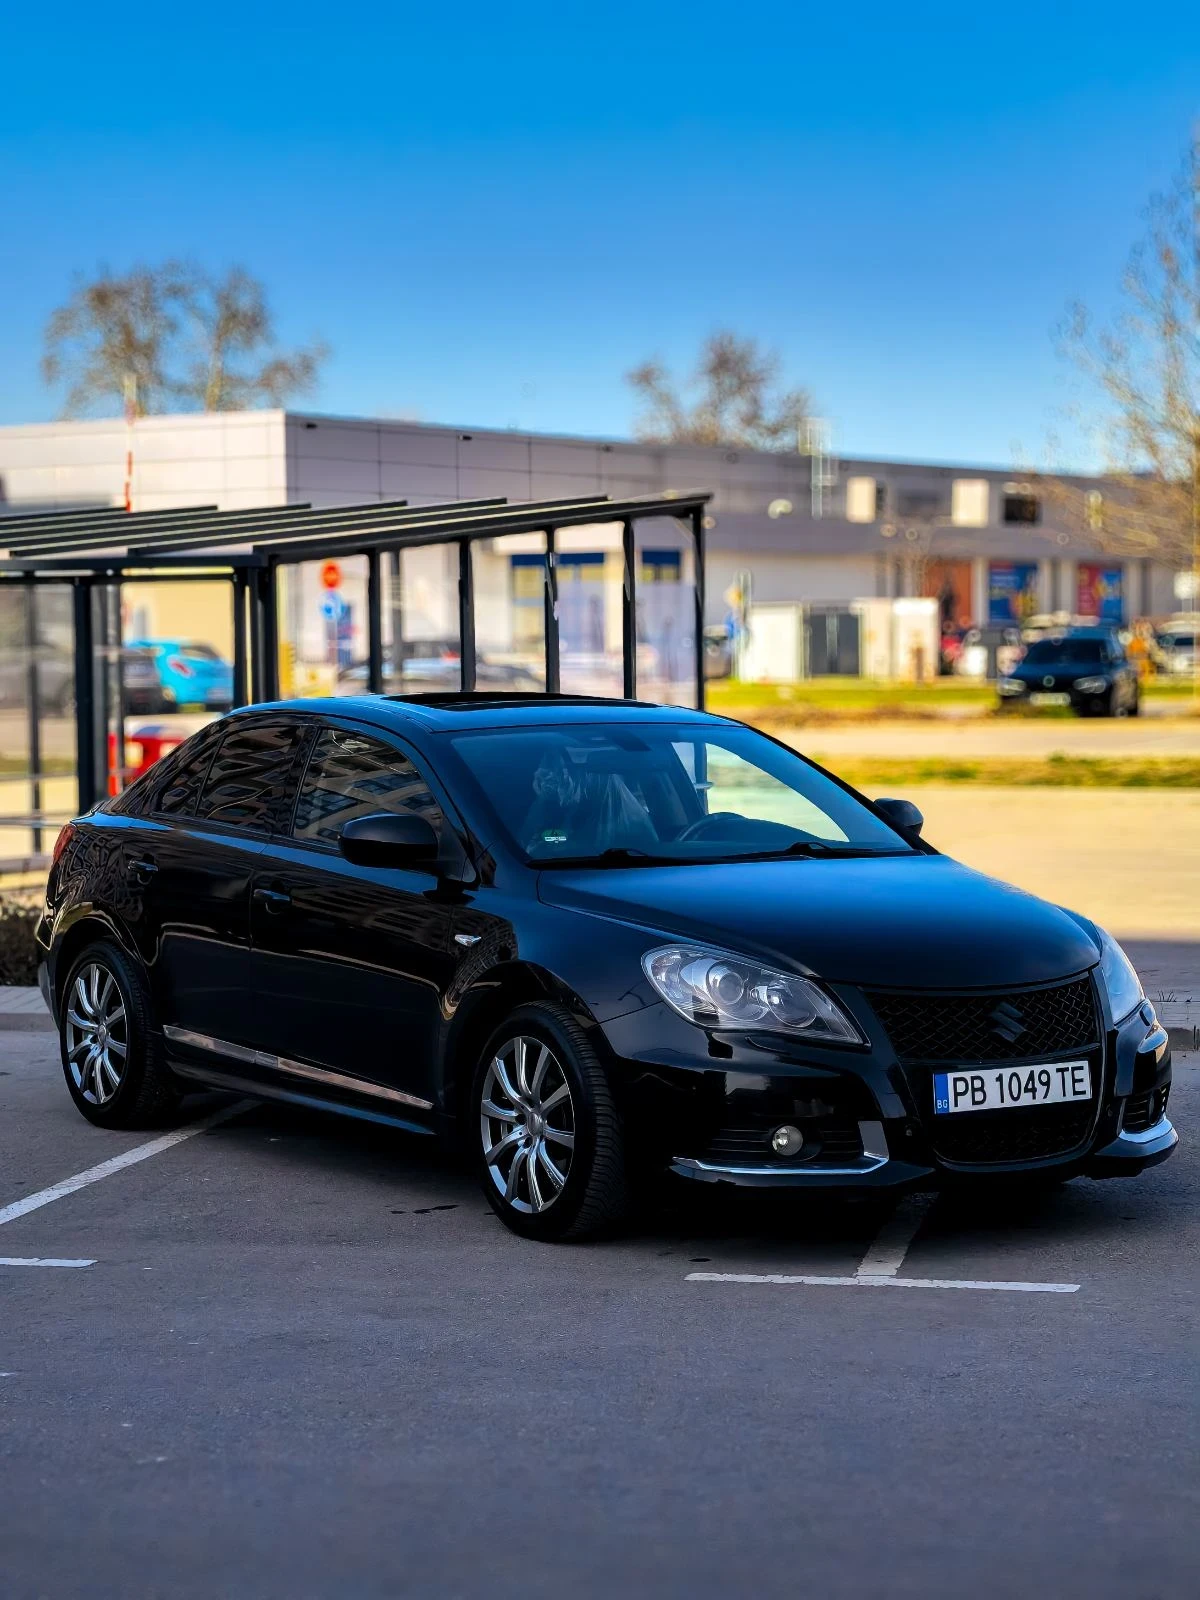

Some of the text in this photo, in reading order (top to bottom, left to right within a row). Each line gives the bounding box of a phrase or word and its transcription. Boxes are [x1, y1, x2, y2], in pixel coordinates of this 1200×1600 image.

[953, 1065, 1086, 1107] PB 1049 TE
[937, 1099, 948, 1109] BG
